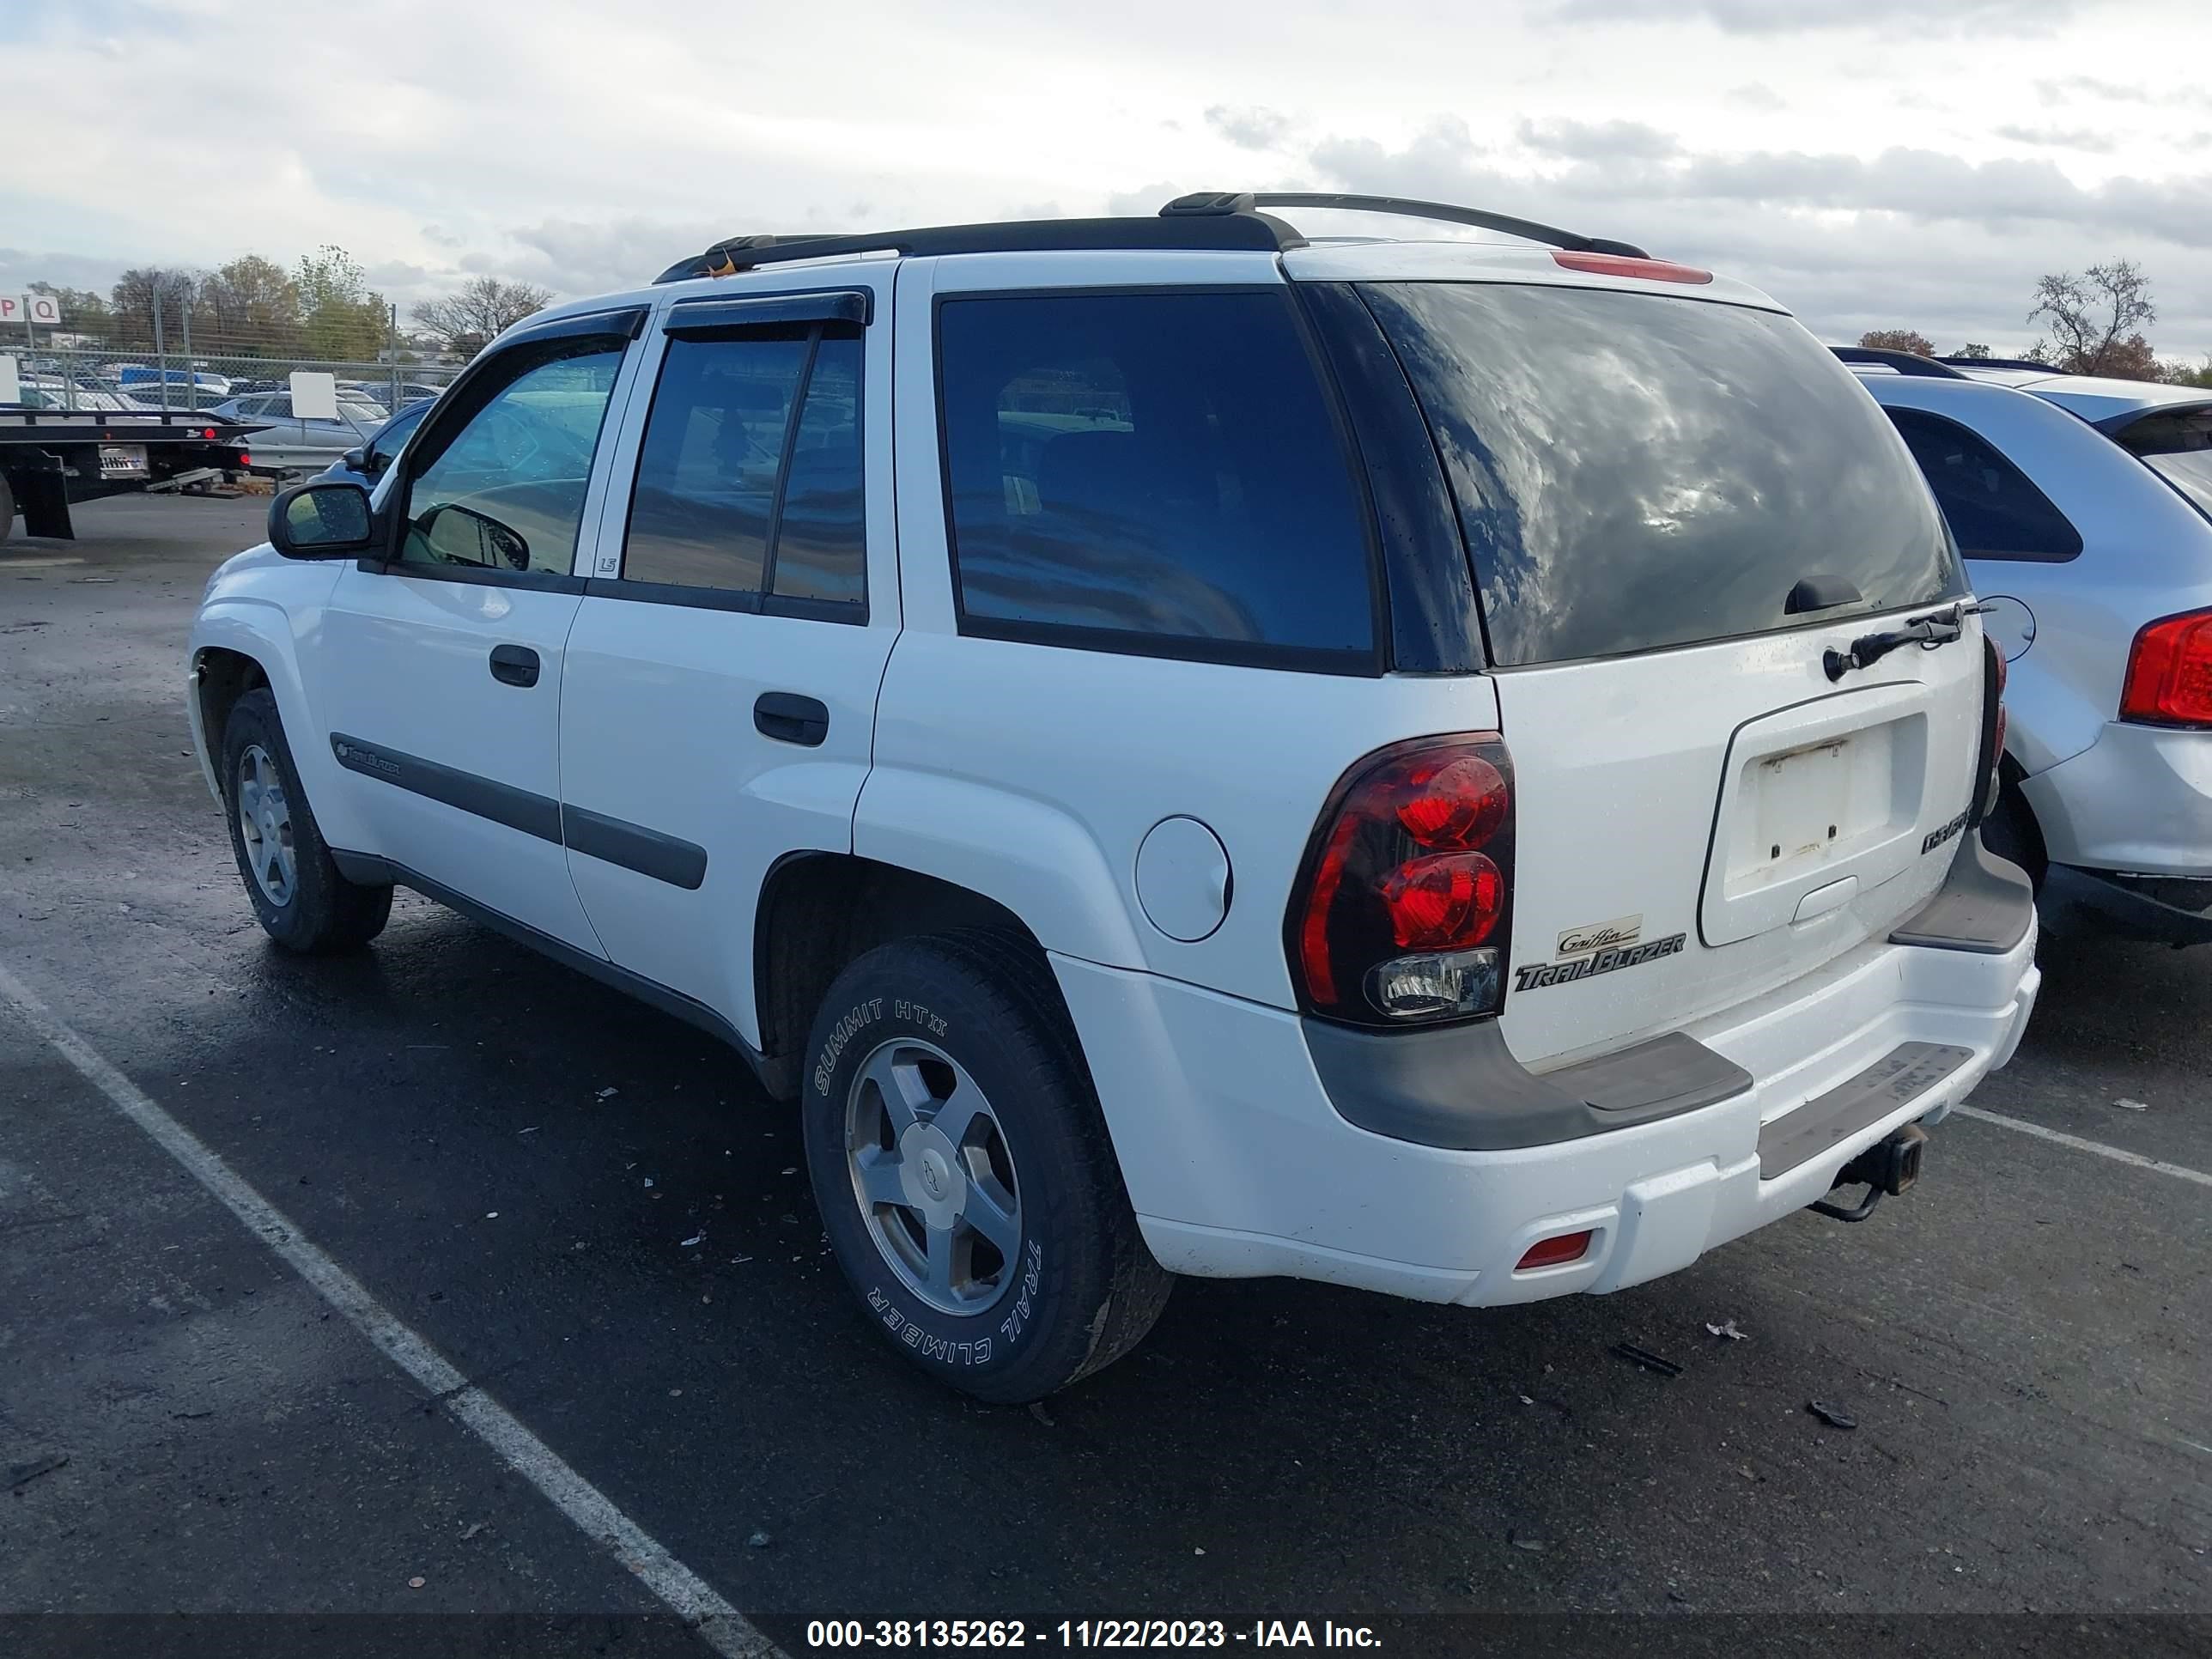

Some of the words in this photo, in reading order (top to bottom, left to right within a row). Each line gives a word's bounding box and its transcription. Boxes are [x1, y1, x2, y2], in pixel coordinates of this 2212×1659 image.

[1, 299, 15, 317] P
[35, 301, 56, 319] Q
[599, 557, 617, 572] LS
[1922, 802, 1973, 855] CHEVRO
[1515, 933, 1686, 992] TRAILBLAZER
[1559, 928, 1641, 952] Griffin
[815, 998, 883, 1096] SUMMIT
[1000, 1239, 1042, 1342] TRAIL
[867, 1287, 992, 1364] CLIMBER
